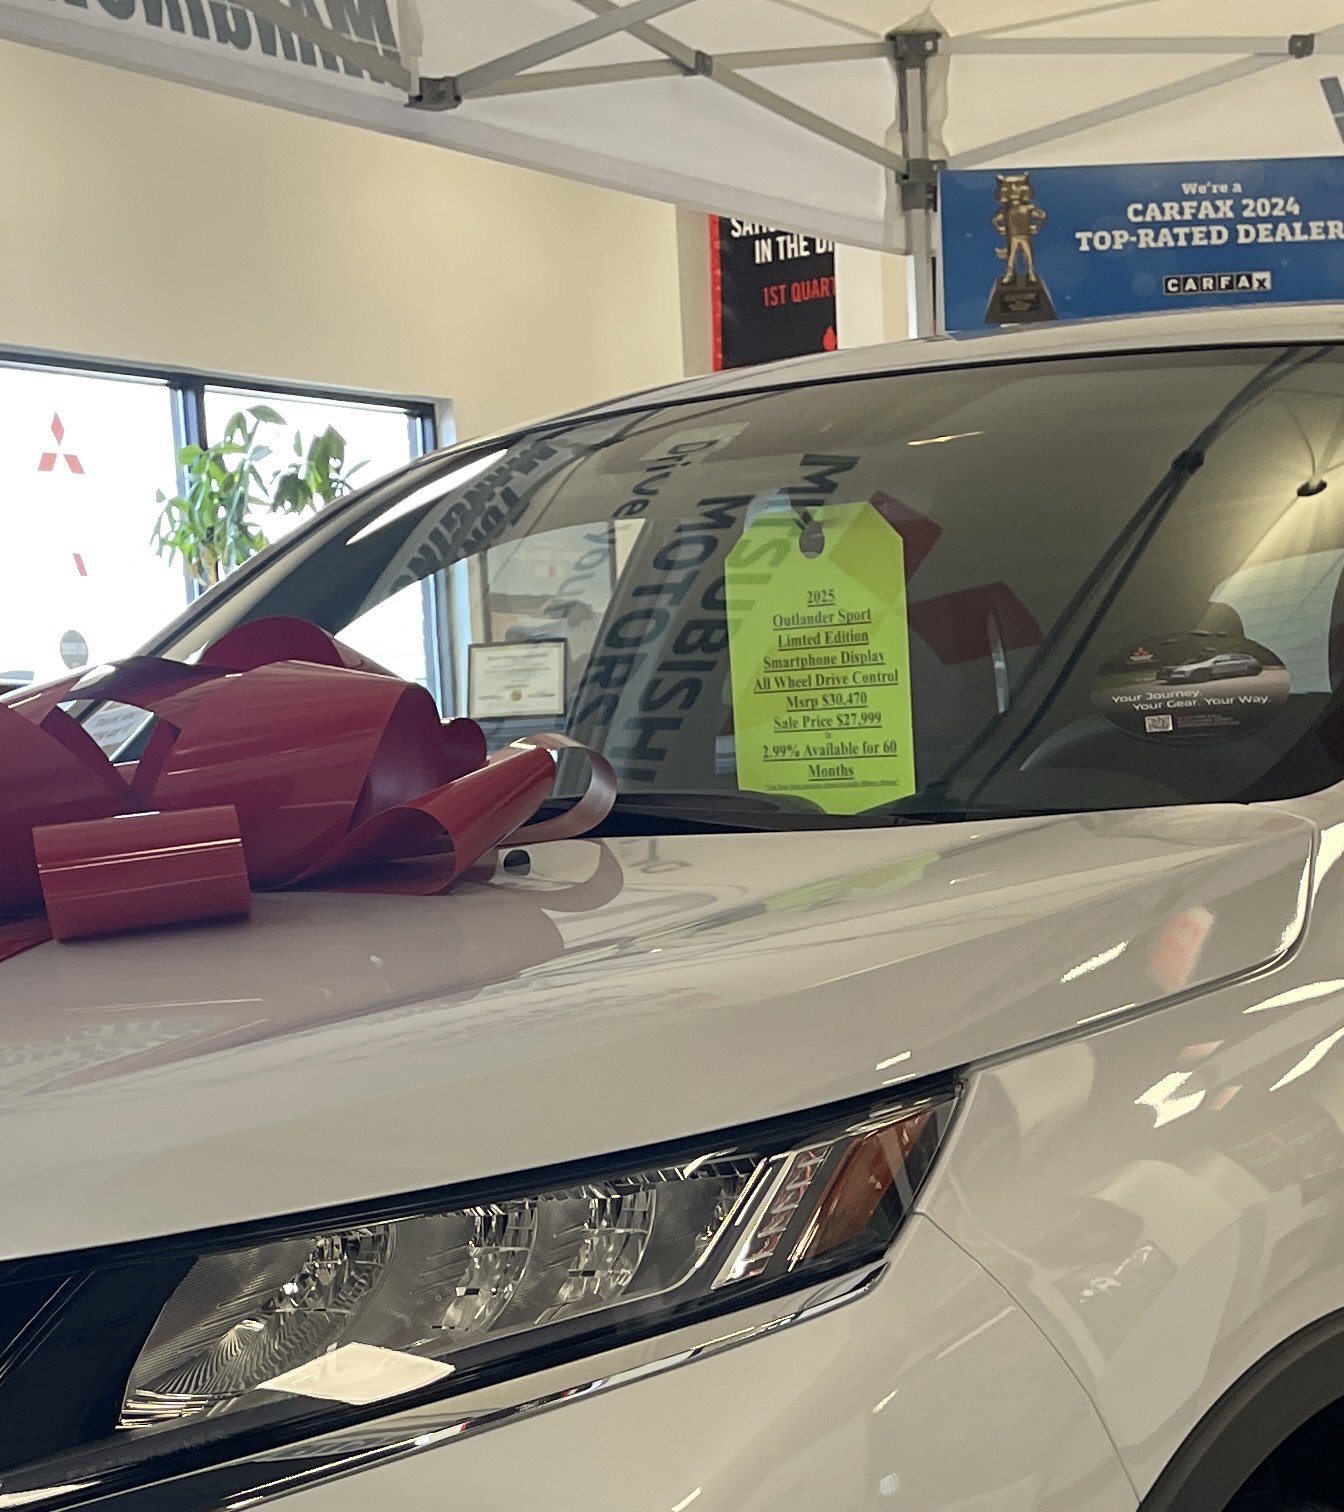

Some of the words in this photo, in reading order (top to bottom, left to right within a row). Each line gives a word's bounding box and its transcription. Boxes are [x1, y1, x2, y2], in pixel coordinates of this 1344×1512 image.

[1181, 181, 1229, 196] We're
[1233, 182, 1243, 194] a
[1127, 199, 1235, 223] CARFAX
[1242, 197, 1301, 218] 2024
[1075, 225, 1229, 252] TOP-RATED
[754, 237, 773, 264] IN
[776, 233, 810, 261] THE
[1164, 273, 1270, 296] CARFAX
[763, 284, 787, 307] 1ST
[807, 590, 835, 605] 2025
[773, 611, 835, 628] Outlander
[838, 608, 872, 626] Sport
[825, 630, 869, 645] Edition
[763, 653, 838, 670] Smartphone
[841, 651, 886, 667] Display
[755, 677, 771, 692] All
[774, 675, 812, 689] Wheel
[816, 672, 849, 686] Drive
[852, 669, 899, 684] Control
[786, 695, 819, 711] Msrp
[1112, 695, 1141, 704] Your
[1145, 689, 1201, 700] Journey.
[1132, 702, 1162, 711] Your
[1166, 699, 1201, 710] Gear.
[1205, 697, 1234, 706] Your
[1238, 695, 1272, 705] Way.
[774, 716, 799, 731] Sale
[802, 714, 833, 729] Price
[763, 744, 801, 758] 2.99%
[805, 740, 859, 757] Available
[862, 740, 880, 755] for
[883, 739, 897, 754] 60
[808, 765, 854, 779] Months
